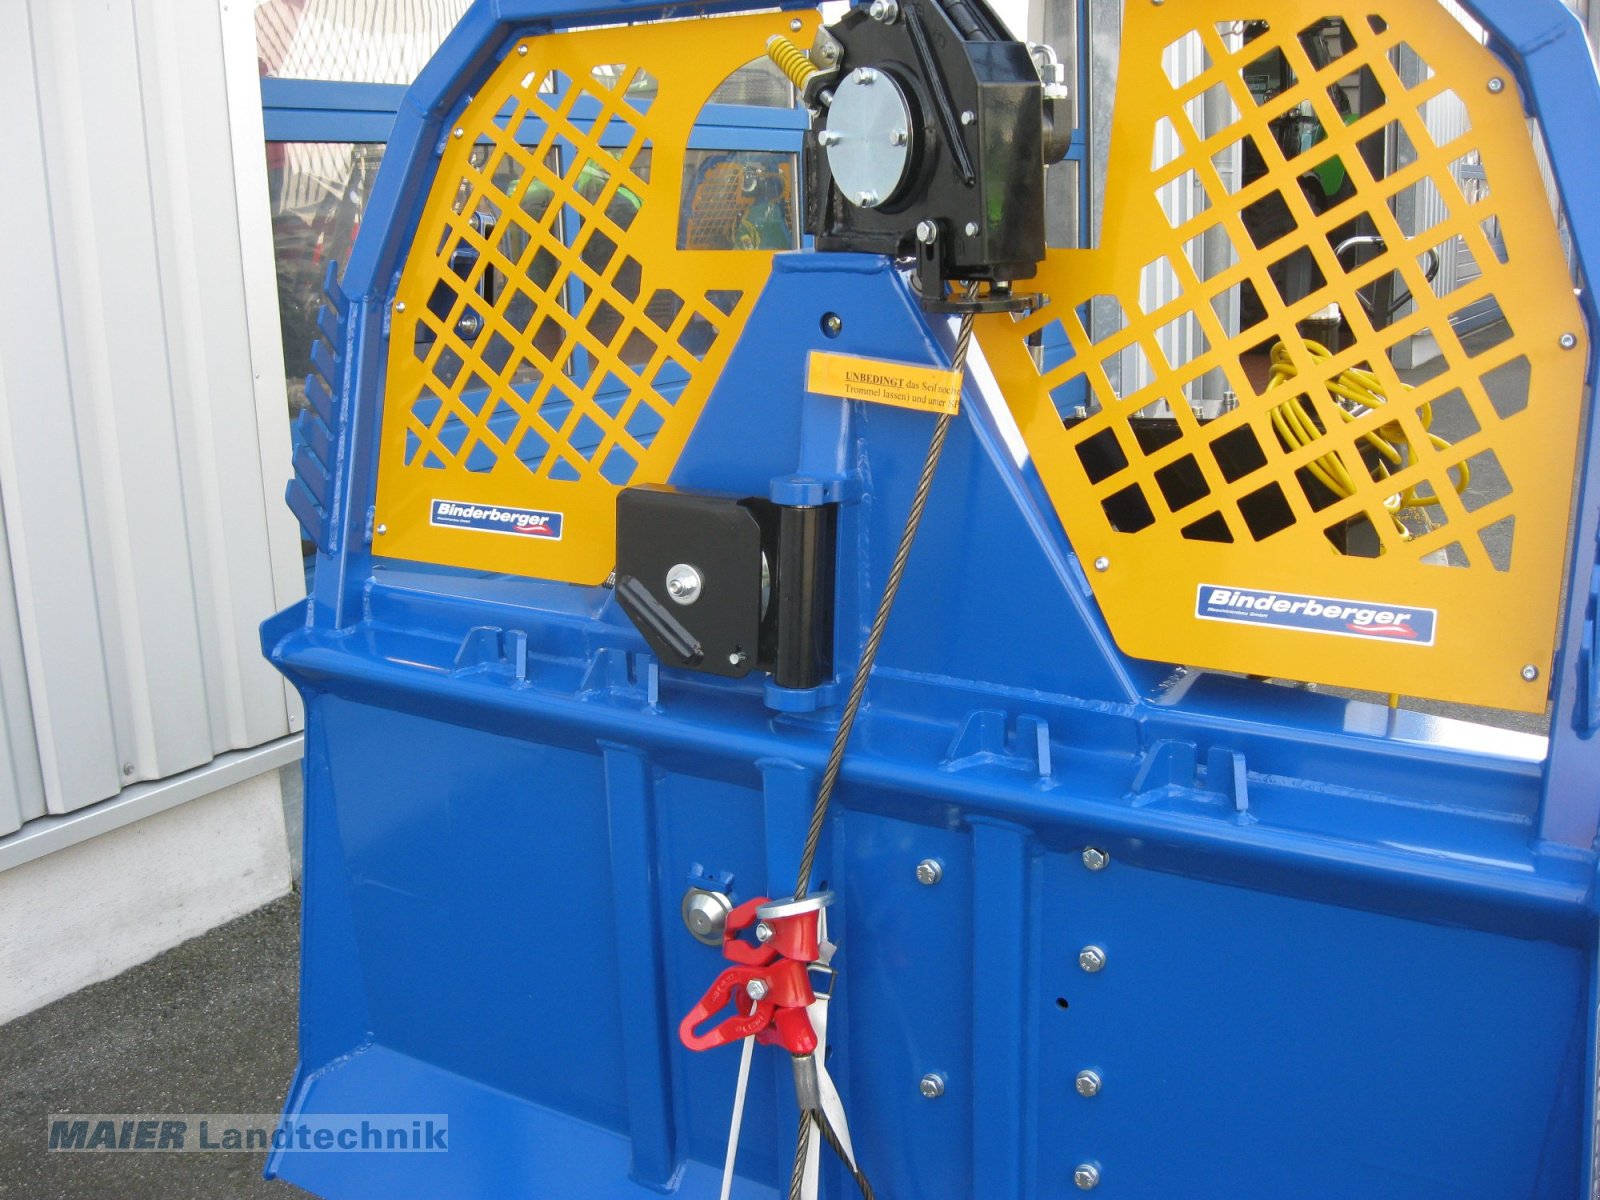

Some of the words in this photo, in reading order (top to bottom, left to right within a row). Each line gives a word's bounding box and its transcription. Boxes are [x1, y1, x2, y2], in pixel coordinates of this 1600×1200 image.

[846, 371, 904, 388] UNBEDINGT
[906, 380, 919, 389] das
[922, 382, 937, 392] Seil
[845, 384, 881, 397] Trommel
[883, 389, 910, 402] lassen)
[912, 395, 926, 404] und
[928, 398, 946, 407] unter
[437, 503, 549, 526] Binderberger
[1208, 589, 1411, 625] Binderberger
